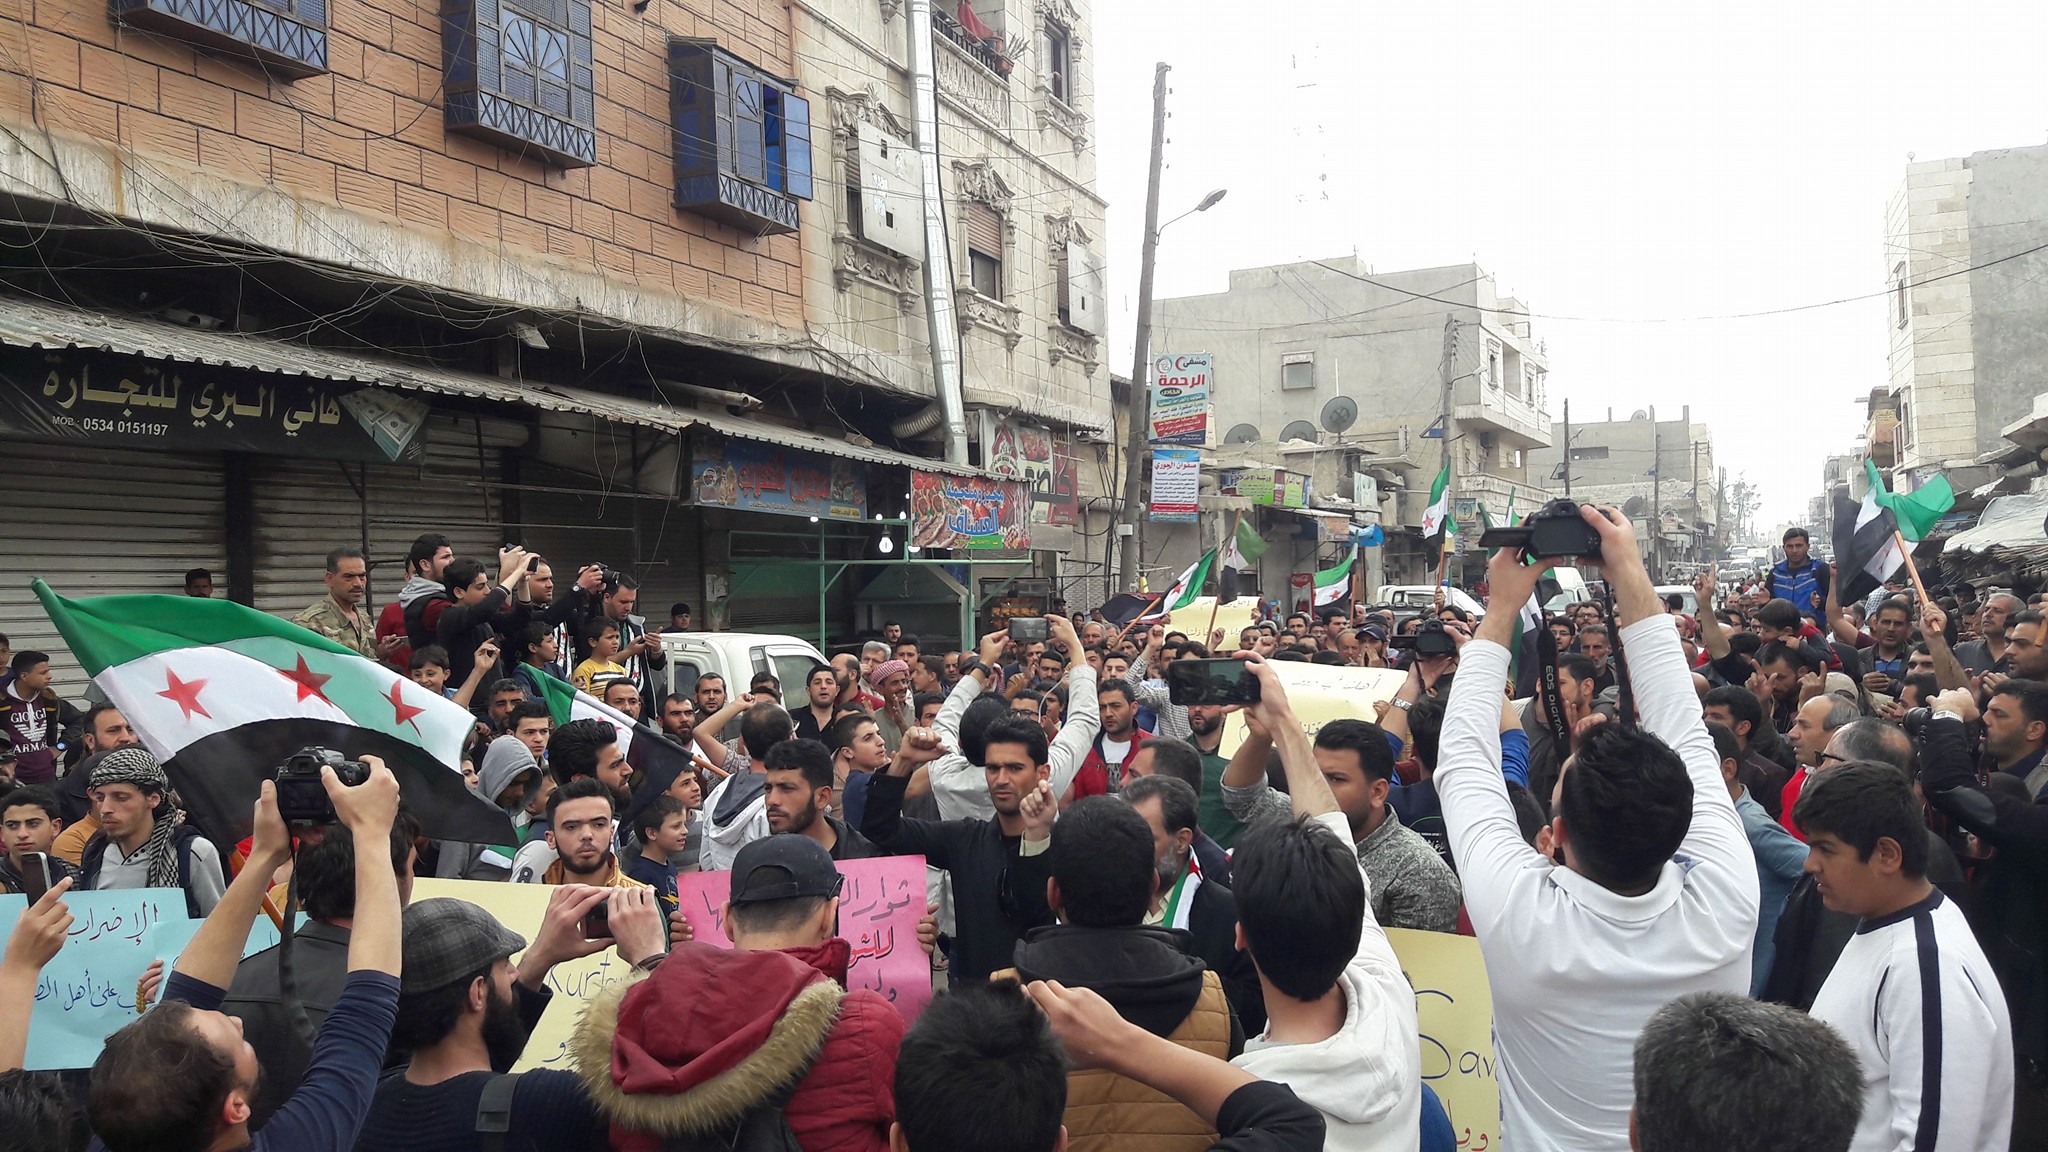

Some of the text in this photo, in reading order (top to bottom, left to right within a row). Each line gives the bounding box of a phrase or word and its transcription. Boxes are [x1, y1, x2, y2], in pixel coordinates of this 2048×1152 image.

[1183, 356, 1207, 369] مشفى
[42, 353, 341, 437] هاني البري للتجارة
[1158, 374, 1206, 388] الرحمة
[83, 417, 115, 433] 0534
[117, 420, 169, 437] 0151197
[947, 507, 999, 536] العساف
[1546, 665, 1567, 740] EOS DIGITAL
[13, 740, 49, 757] ARMA
[851, 876, 911, 922] ثوار
[63, 968, 91, 1011] أهل
[548, 953, 623, 998] Kurt
[90, 980, 118, 1008] على
[1415, 989, 1499, 1083] Sav
